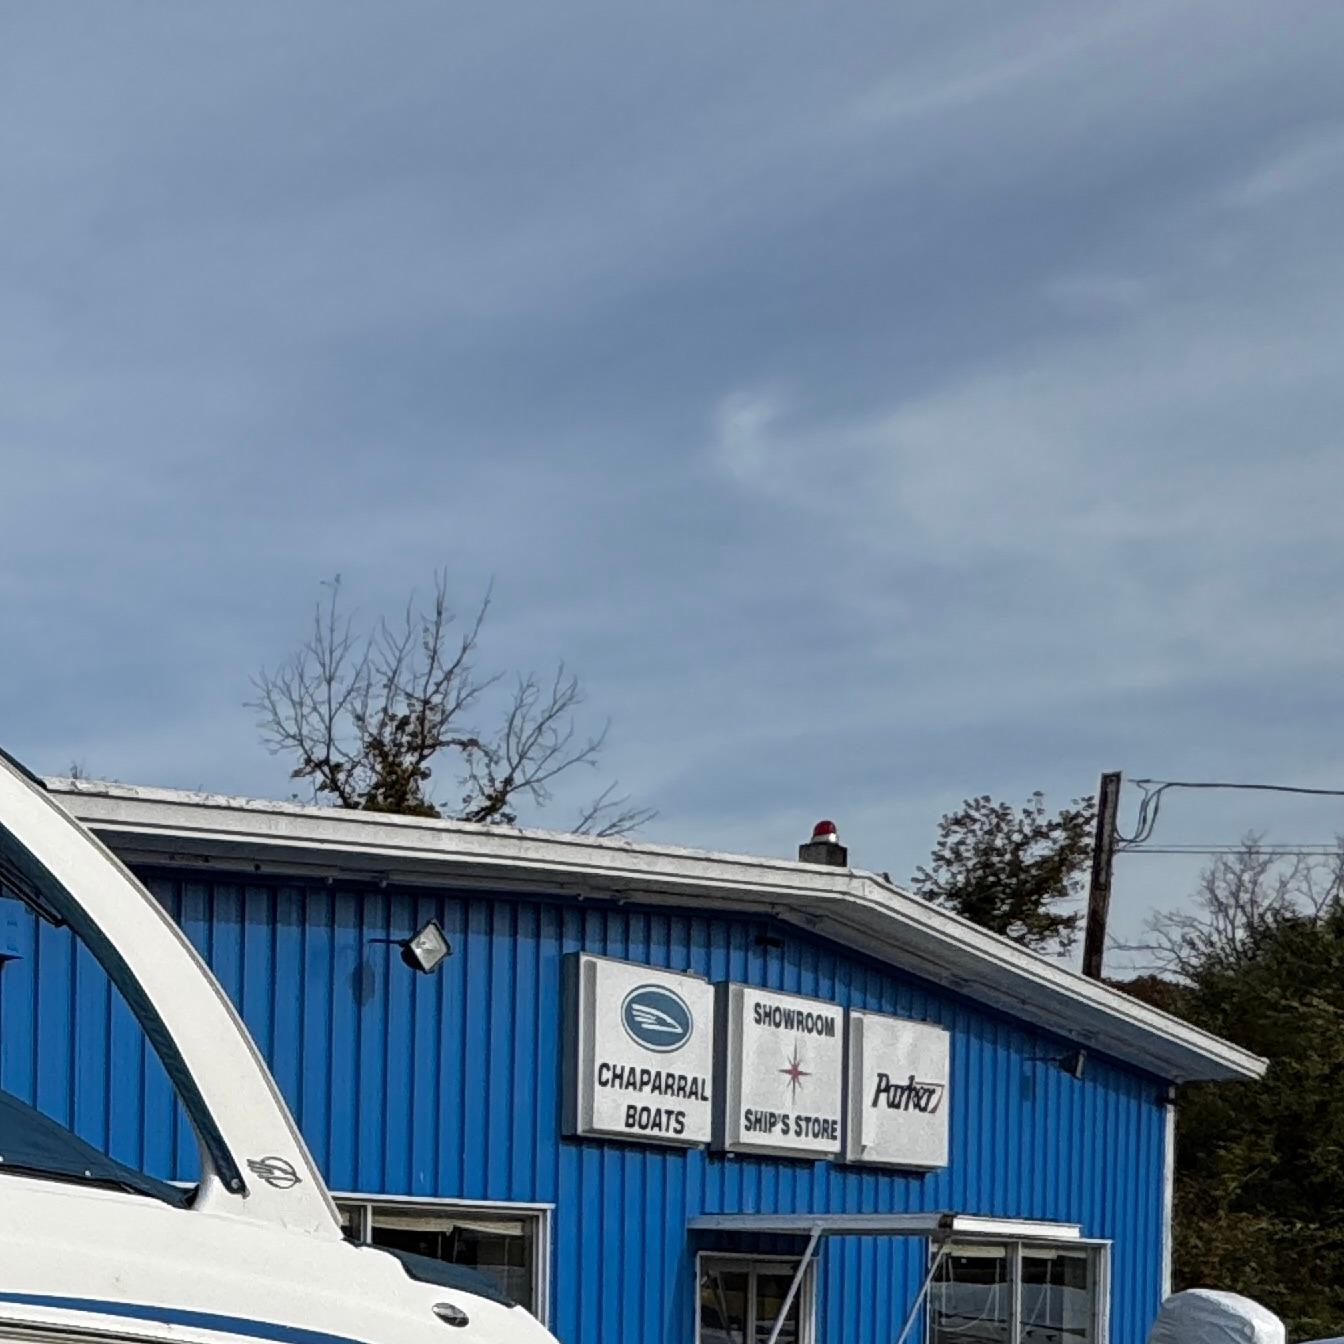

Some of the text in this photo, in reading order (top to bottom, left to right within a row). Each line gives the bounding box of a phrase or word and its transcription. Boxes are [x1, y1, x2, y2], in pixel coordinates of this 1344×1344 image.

[753, 1002, 836, 1039] SHOWROOM
[597, 1061, 710, 1103] CHAPARRAL
[871, 1072, 936, 1113] Parker
[624, 1104, 687, 1135] BOATS
[744, 1108, 839, 1142] SHIP'S STORE
